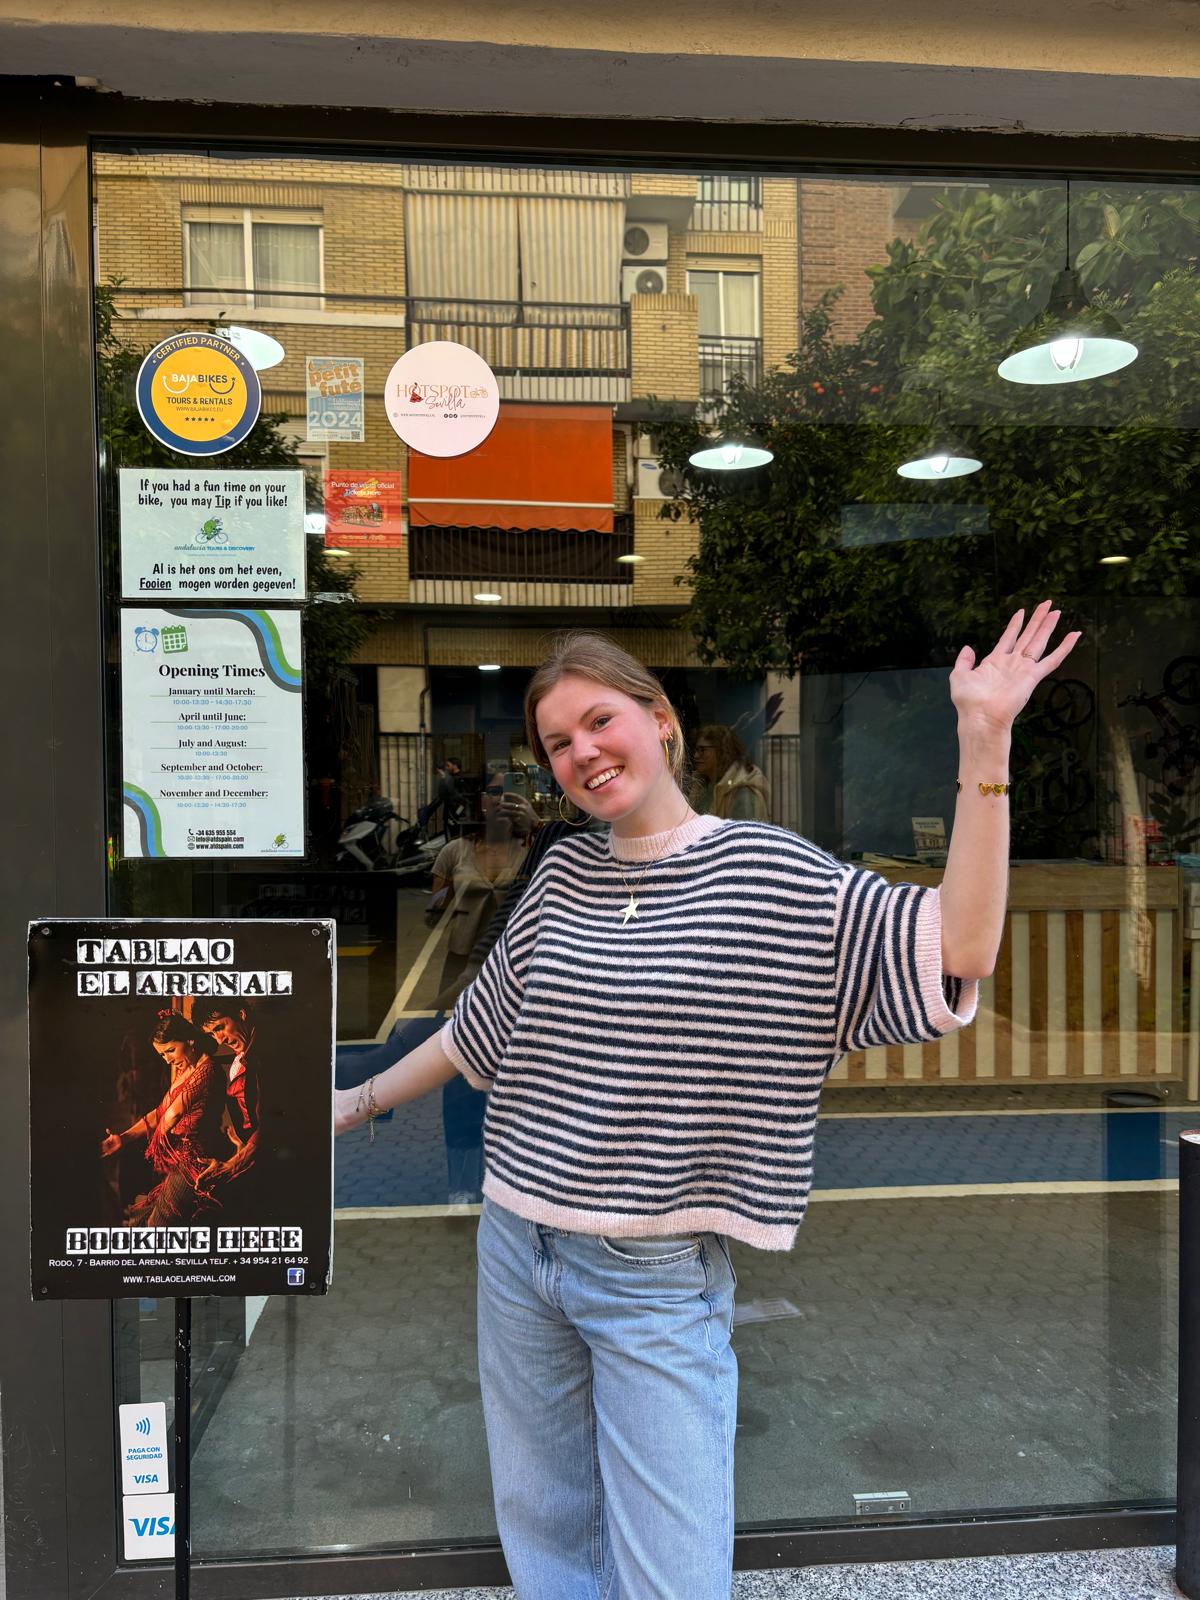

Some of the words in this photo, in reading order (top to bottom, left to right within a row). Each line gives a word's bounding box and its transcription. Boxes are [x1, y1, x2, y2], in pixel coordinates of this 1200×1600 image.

[156, 336, 198, 360] CERTIFIED
[200, 337, 240, 361] PARTNER
[309, 364, 359, 387] petit
[396, 384, 470, 398] HOTSPOT
[167, 396, 192, 404] TOURS
[200, 397, 233, 405] RENTALS
[424, 388, 466, 411] Sevilla
[309, 410, 362, 428] 2024
[140, 479, 149, 491] If
[152, 482, 169, 494] you
[172, 479, 190, 492] had
[194, 483, 200, 492] a
[203, 480, 220, 492] fun
[224, 482, 246, 492] time
[249, 483, 261, 492] on
[265, 484, 286, 495] your
[138, 494, 163, 507] bike,
[170, 497, 187, 509] you
[191, 497, 212, 509] may
[215, 495, 231, 509] Tip
[234, 495, 243, 507] if
[245, 498, 262, 509] you
[266, 496, 288, 507] like!
[152, 563, 164, 574] Al
[168, 565, 176, 574] is
[180, 564, 195, 574] het
[199, 566, 215, 575] ons
[219, 566, 234, 575] om
[238, 564, 254, 575] het
[256, 567, 282, 577] even,
[139, 577, 172, 590] Fooien
[179, 580, 211, 591] mogen
[214, 578, 249, 589] worden
[253, 578, 296, 592] gegeven!
[159, 664, 219, 679] Opening
[222, 664, 265, 677] Times
[168, 687, 202, 697] January
[203, 687, 223, 696] until
[225, 688, 256, 696] March:
[179, 713, 200, 722] April
[203, 713, 223, 721] until
[224, 713, 246, 722] June:
[178, 739, 195, 748] July
[197, 739, 212, 747] and
[214, 740, 247, 748] August:
[161, 764, 206, 772] September
[208, 764, 224, 772] and
[226, 764, 263, 772] October:
[160, 789, 203, 798] November
[205, 789, 221, 798] and
[223, 790, 268, 798] December:
[78, 940, 232, 963] TABLAO
[79, 972, 128, 995] EL
[137, 972, 291, 995] ARENAL
[68, 1230, 210, 1252] BOOKING
[218, 1230, 300, 1250] HERE
[240, 1257, 251, 1265] 34
[297, 1256, 309, 1264] 92
[123, 1274, 236, 1283] WWW.TABLAOELARENAL.COM
[126, 1453, 163, 1461] SEGURIDAD
[132, 1474, 159, 1484] VISA
